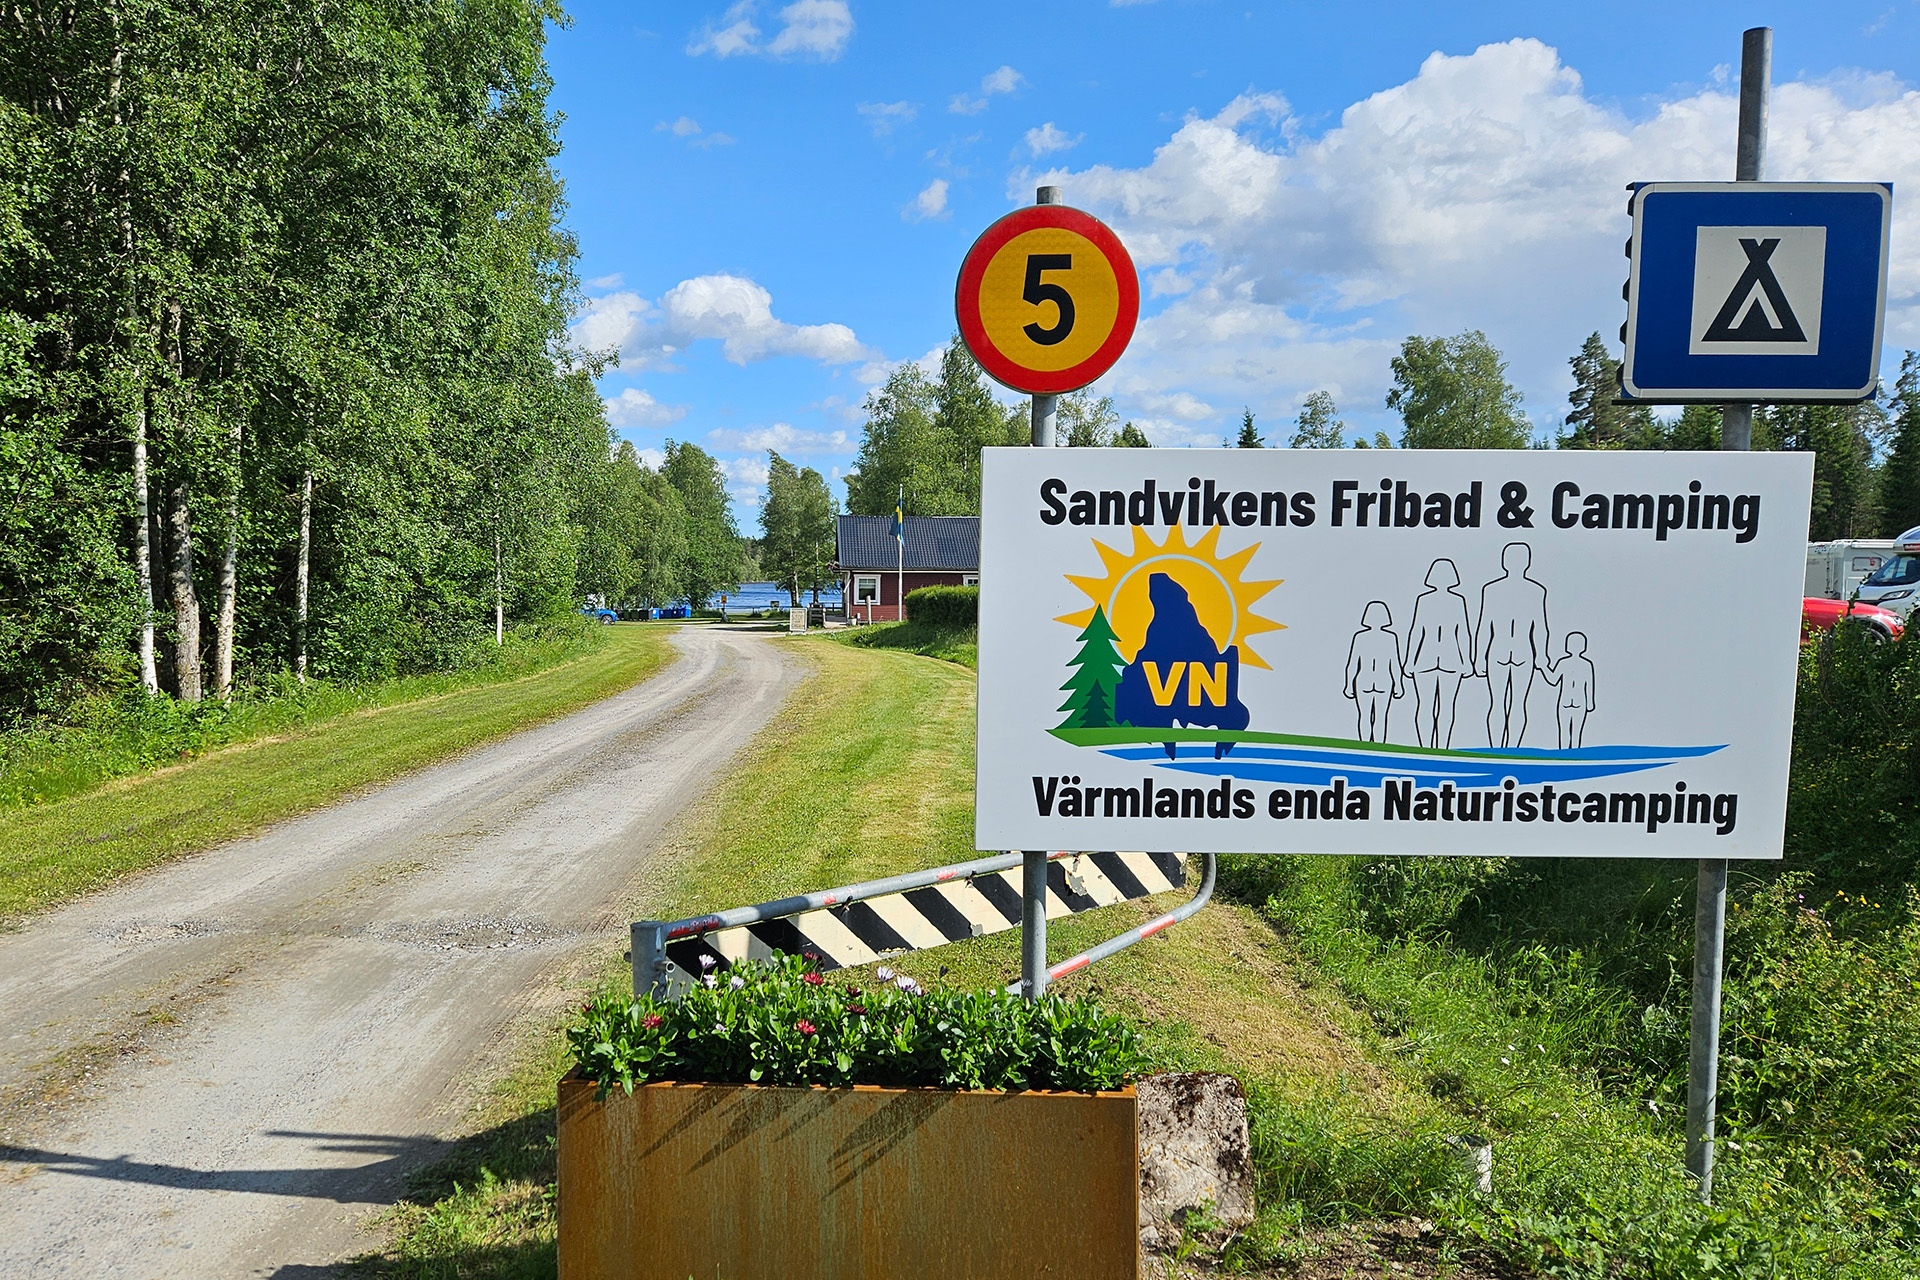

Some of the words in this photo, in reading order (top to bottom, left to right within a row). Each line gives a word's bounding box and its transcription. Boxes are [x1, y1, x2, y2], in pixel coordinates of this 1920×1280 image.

[1022, 253, 1076, 346] 5
[1039, 478, 1316, 527] Sandvikens
[1330, 478, 1483, 529] Fribad
[1496, 480, 1535, 529] &
[1551, 480, 1761, 543] Camping
[1142, 661, 1228, 706] VN
[1032, 775, 1256, 819] Värmlands
[1268, 779, 1370, 821] enda
[1383, 780, 1738, 836] Naturistcamping
